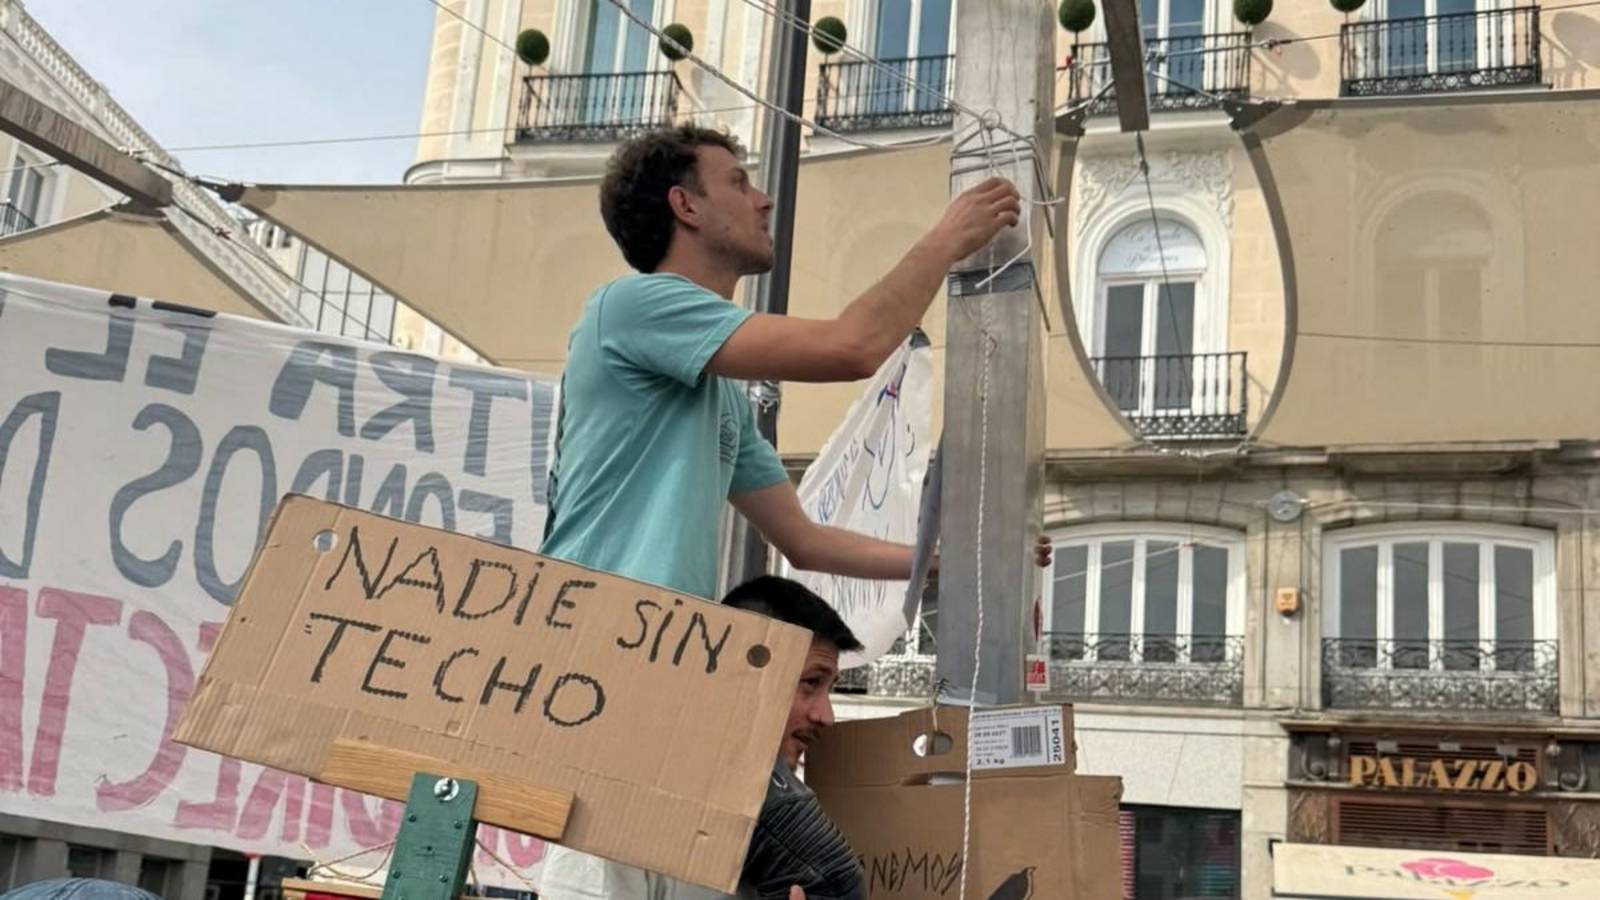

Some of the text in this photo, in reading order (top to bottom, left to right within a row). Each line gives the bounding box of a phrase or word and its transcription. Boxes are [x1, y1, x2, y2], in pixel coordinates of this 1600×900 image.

[309, 612, 606, 727] TECHO
[1051, 719, 1063, 762] 25041
[1350, 755, 1538, 792] PALAZZO
[859, 847, 963, 897] NEMOS
